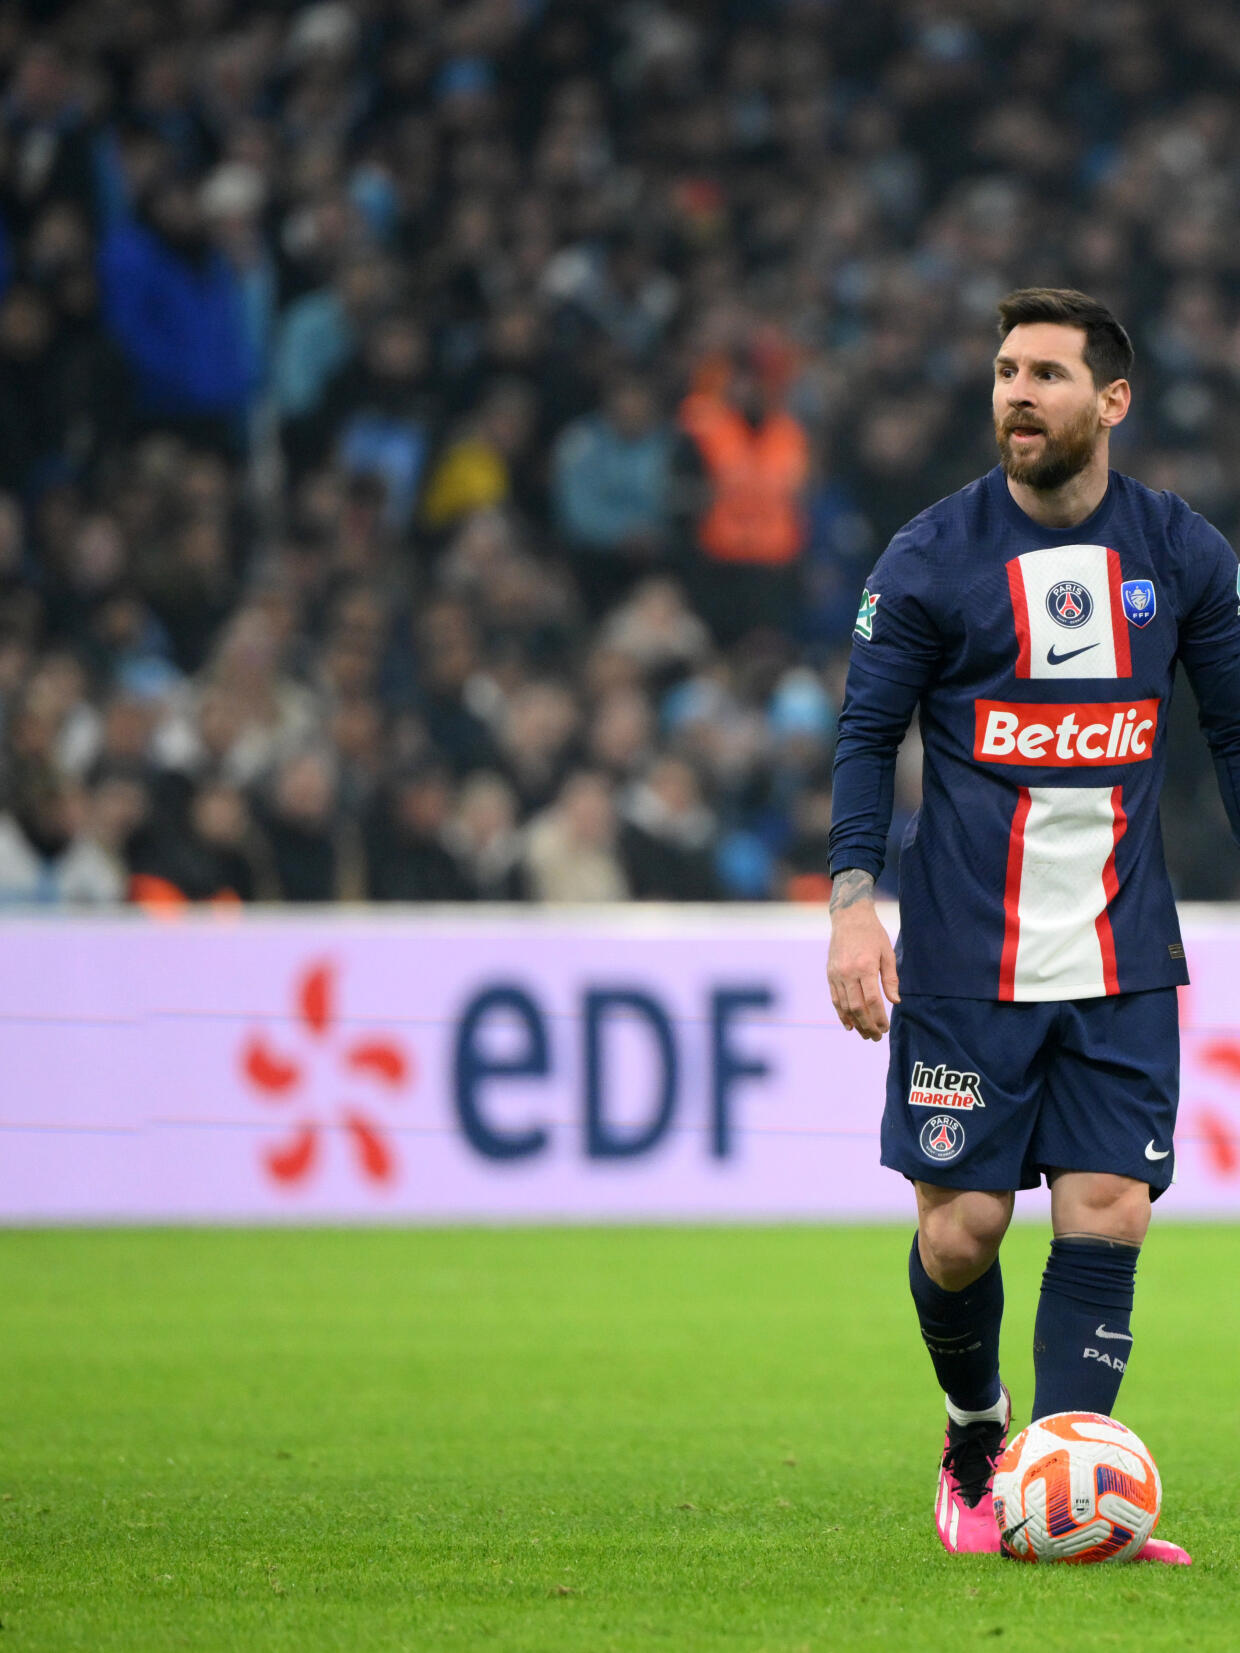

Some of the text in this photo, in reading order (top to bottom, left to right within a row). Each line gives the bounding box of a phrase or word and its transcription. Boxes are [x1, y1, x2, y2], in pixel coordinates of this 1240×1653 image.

[1053, 584, 1083, 597] PARIS
[981, 708, 1153, 760] Betclic
[930, 1117, 959, 1131] PARIS
